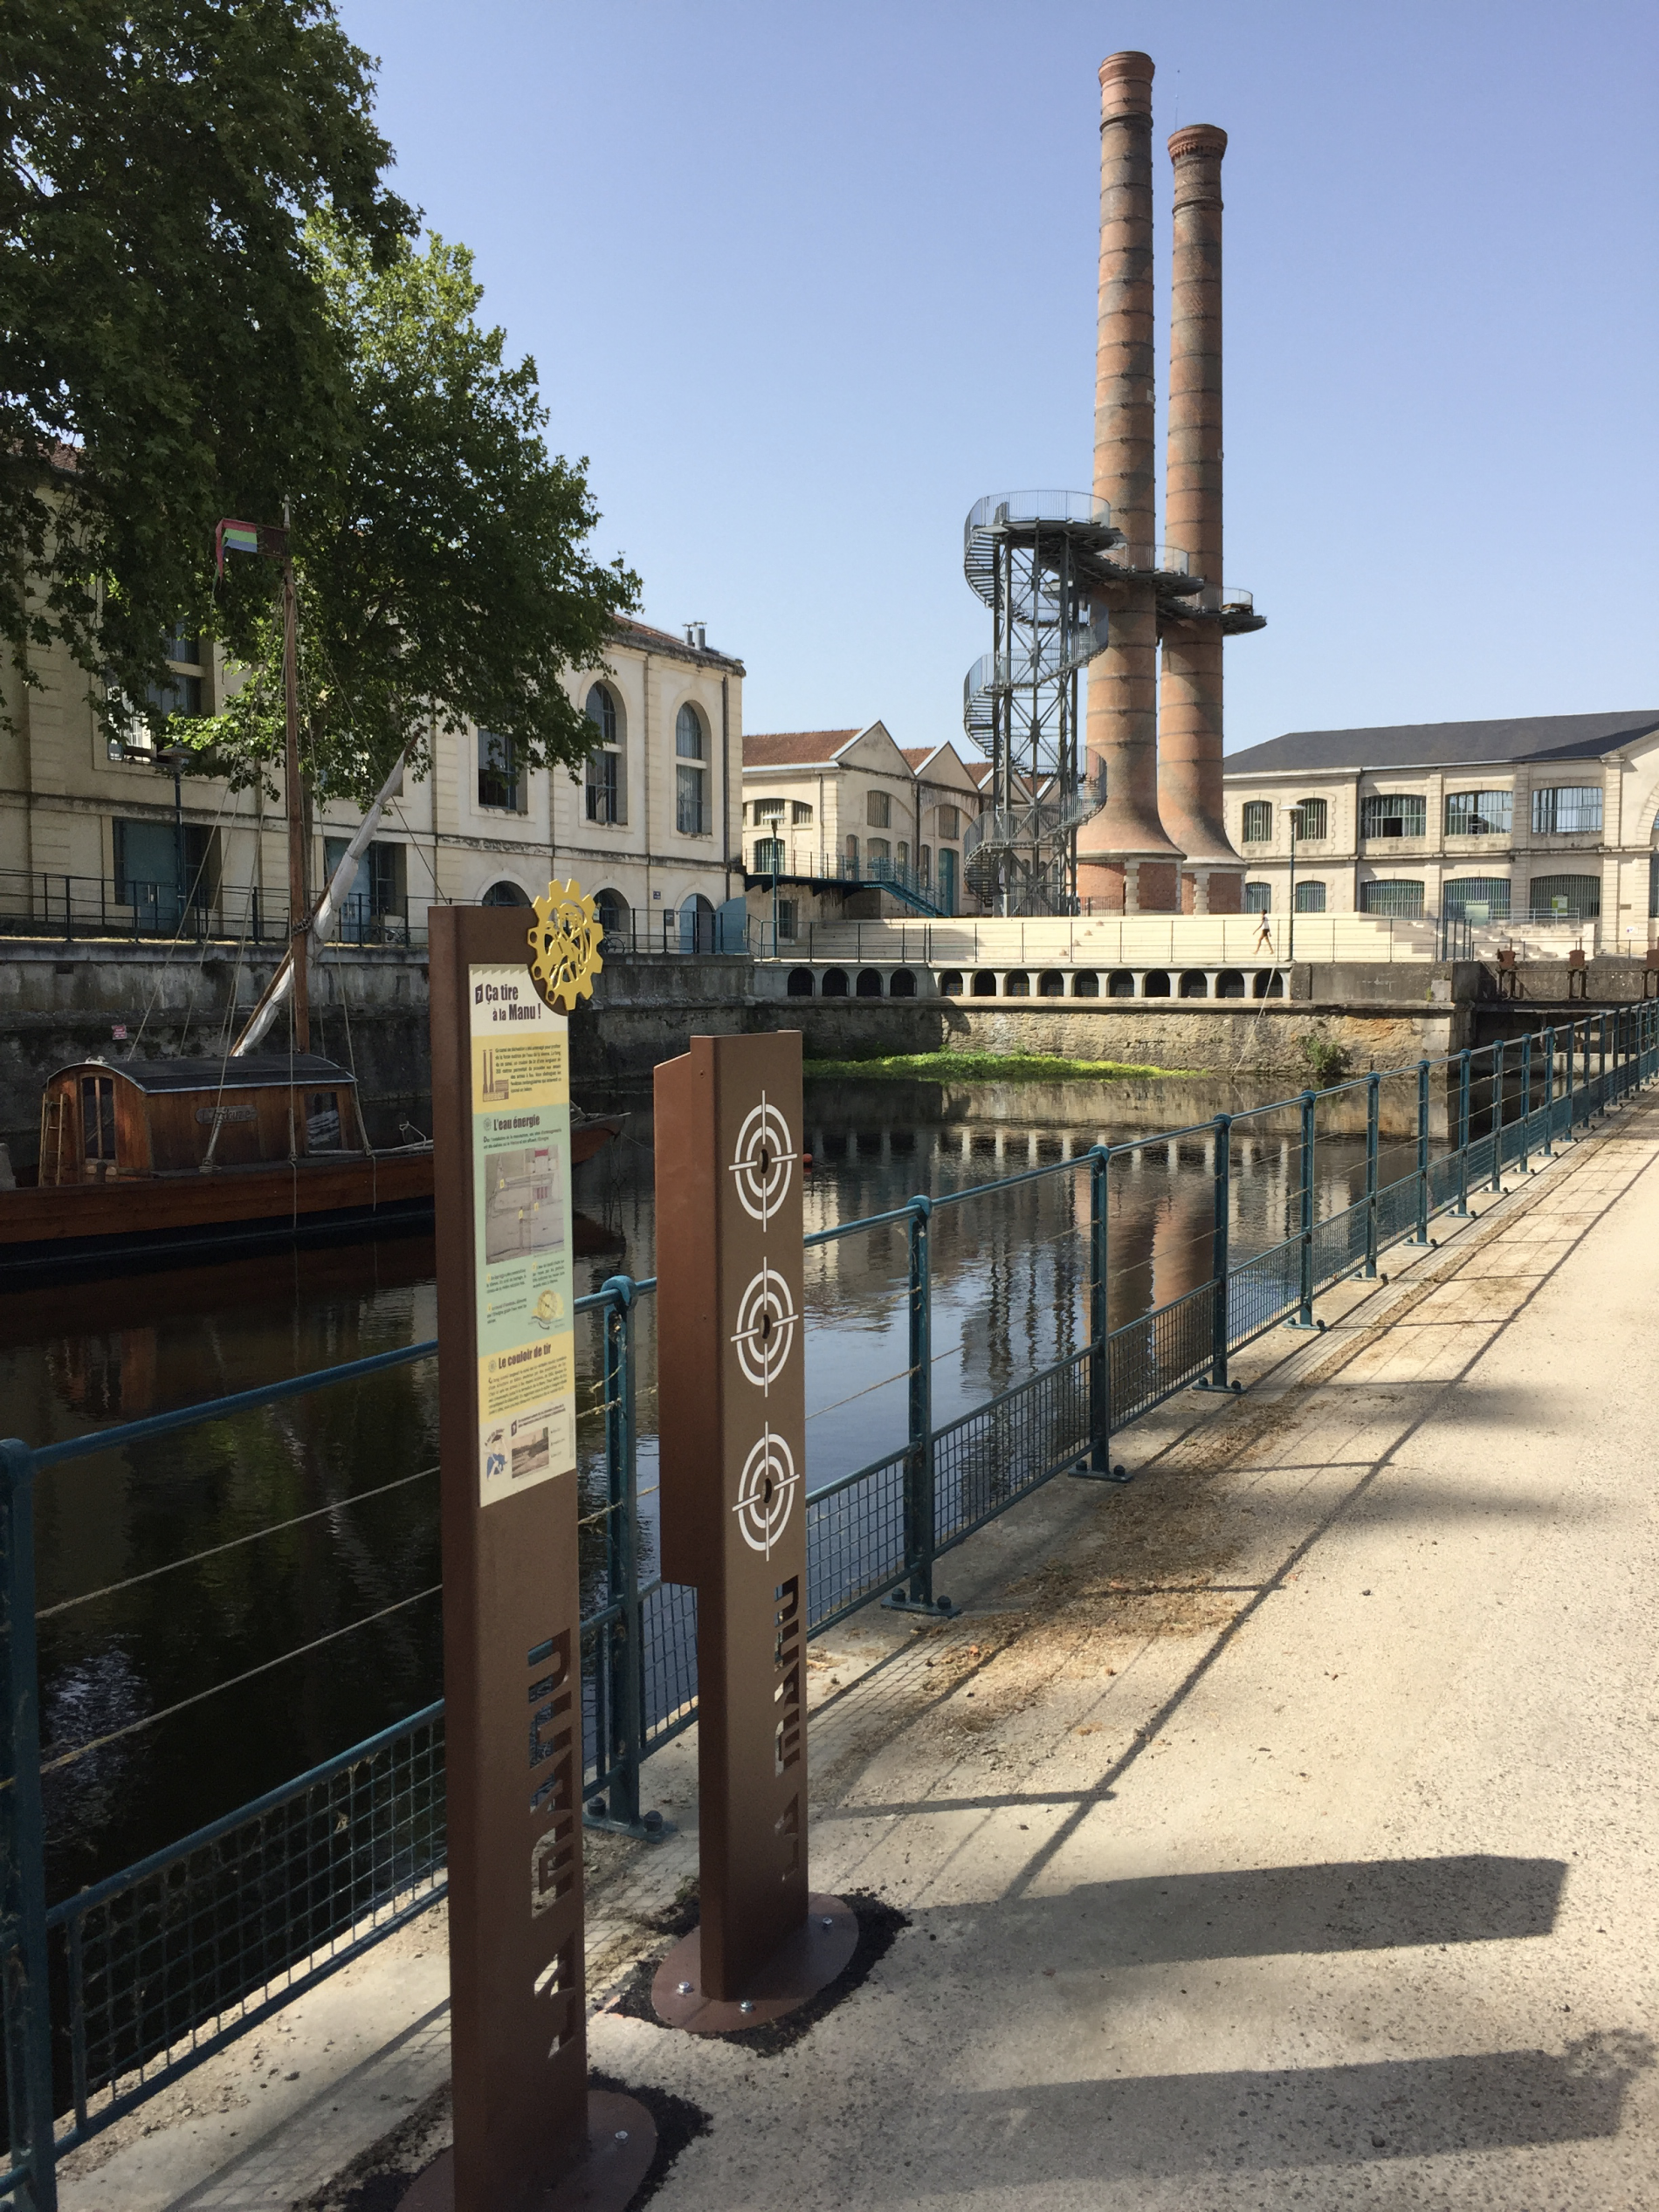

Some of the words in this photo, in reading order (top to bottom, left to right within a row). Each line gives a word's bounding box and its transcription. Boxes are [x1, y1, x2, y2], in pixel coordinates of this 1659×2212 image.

[485, 984, 499, 1005] Ça
[500, 984, 519, 1001] tire
[492, 1007, 498, 1021] à
[499, 1008, 506, 1021] la
[509, 1004, 535, 1020] Manu
[494, 1119, 513, 1132] L'eau
[513, 1114, 540, 1129] énergie
[499, 1357, 506, 1370] Le
[507, 1348, 533, 1367] couloir
[533, 1345, 542, 1358] de
[543, 1343, 552, 1356] tir
